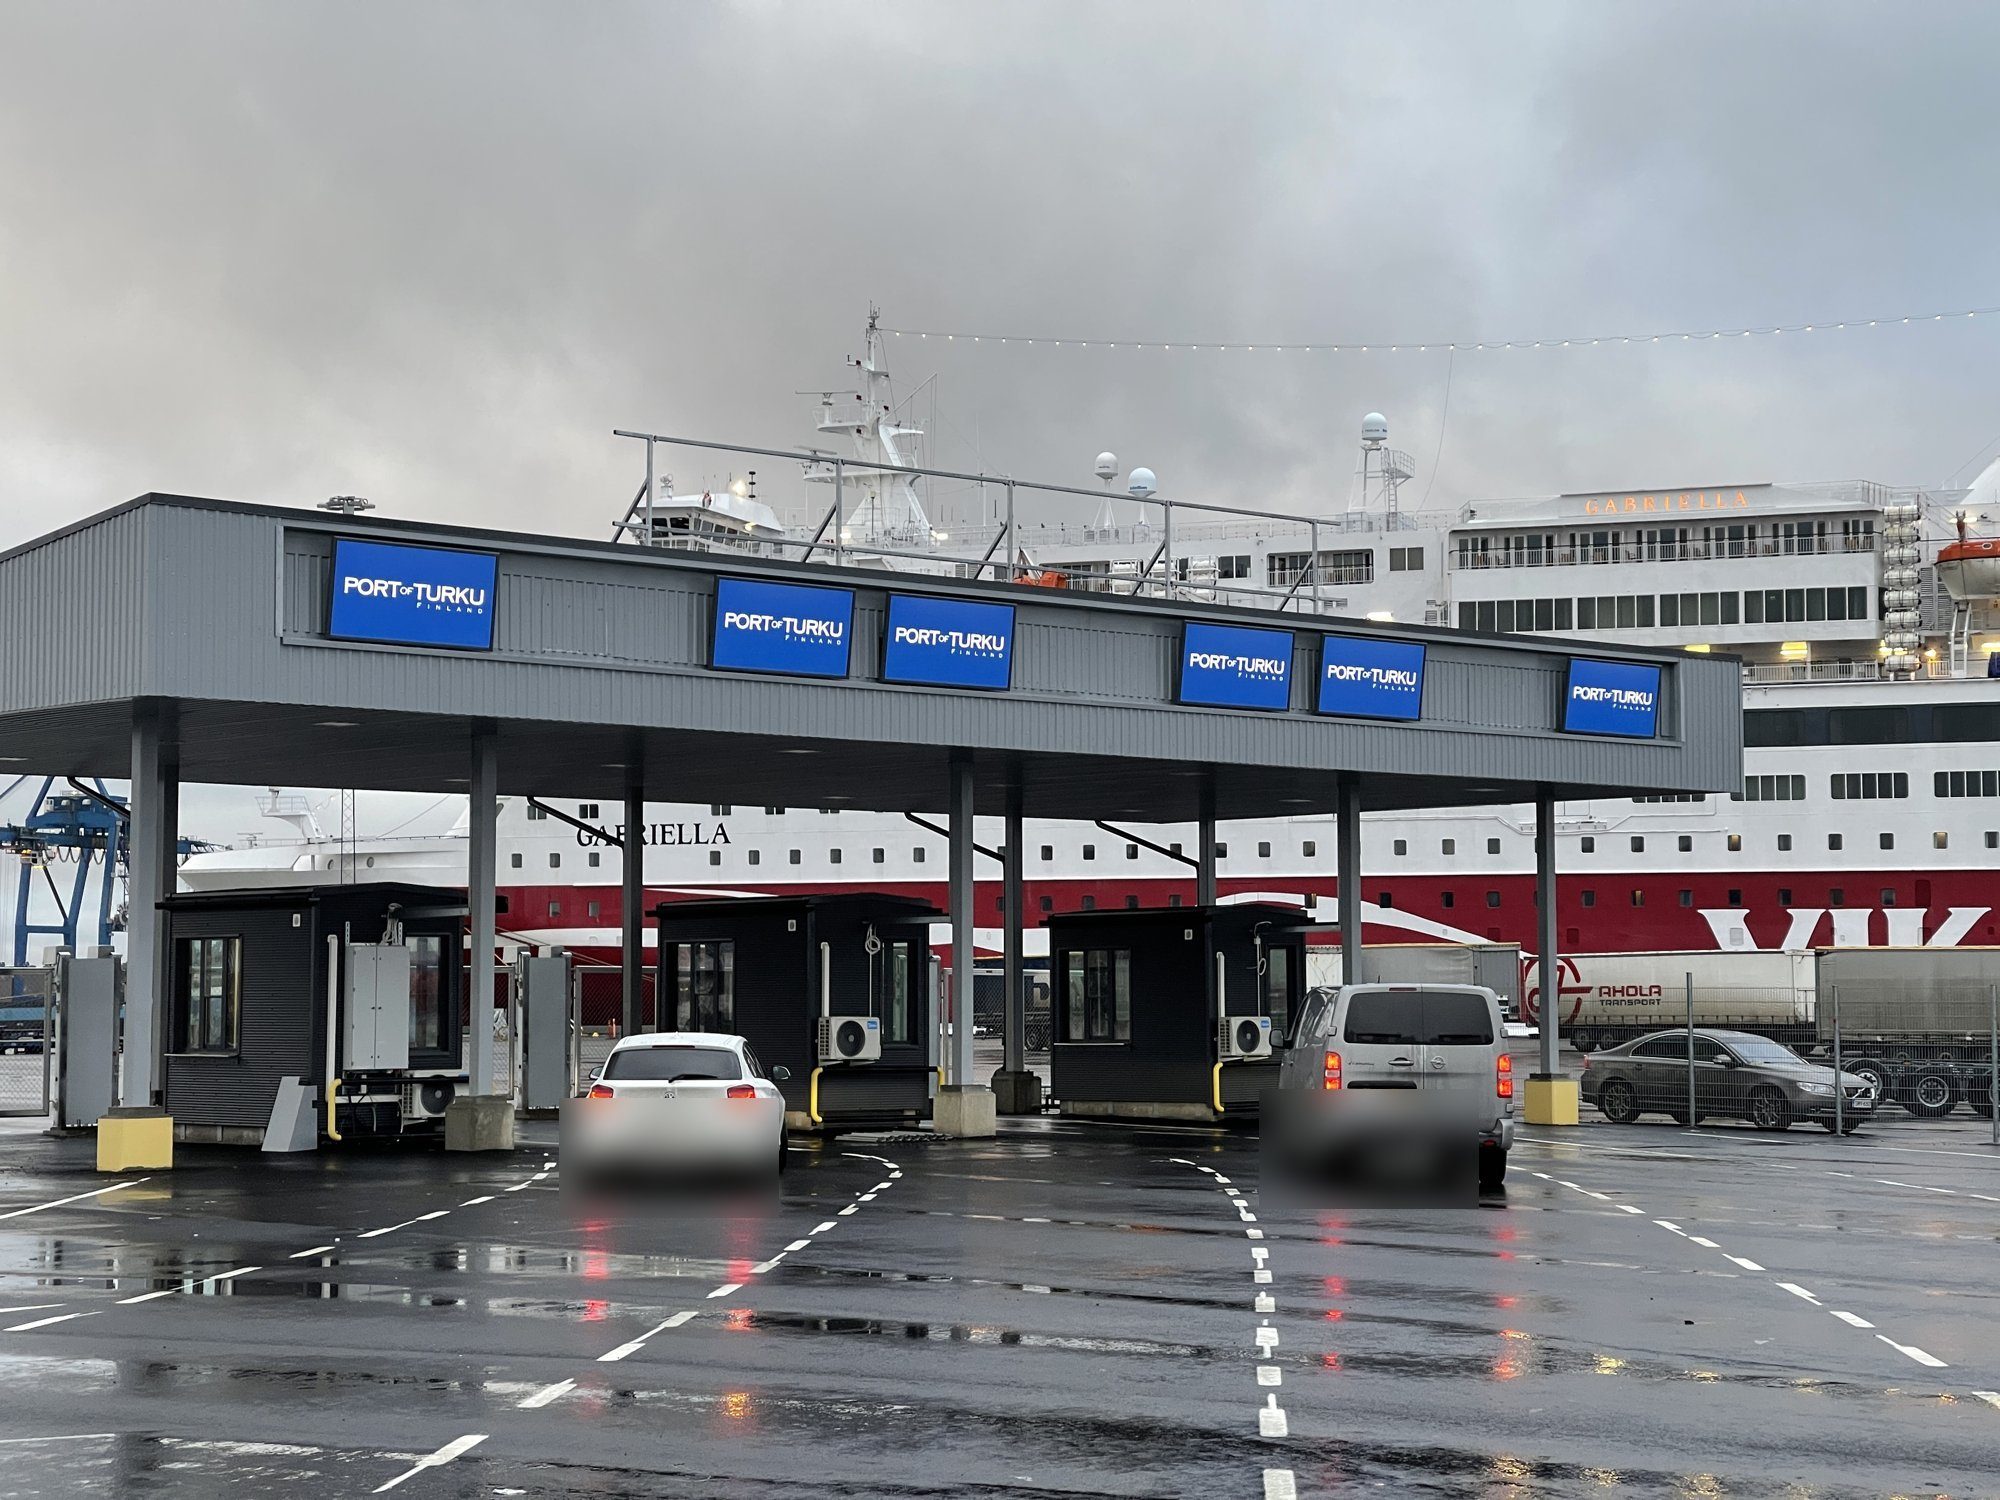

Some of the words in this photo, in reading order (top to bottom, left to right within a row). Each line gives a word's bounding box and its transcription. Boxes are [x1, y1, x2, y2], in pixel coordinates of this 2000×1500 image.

[1584, 490, 1749, 515] GABRIELLA
[344, 576, 402, 598] PORT
[400, 586, 413, 595] OF
[413, 582, 485, 606] TURKU
[416, 602, 483, 614] FINLAND
[724, 612, 773, 631] PORT
[771, 620, 783, 629] OF
[782, 616, 843, 638] TURKU
[784, 634, 842, 645] FINLAND
[895, 626, 940, 645] PORT
[938, 634, 949, 643] OF
[948, 631, 1005, 651] TURKU
[950, 648, 1003, 658] FINLAND
[1189, 652, 1229, 669] PORT
[1227, 659, 1237, 667] OF
[1236, 656, 1285, 674] TURKU
[1327, 664, 1364, 680] PORT
[1363, 671, 1372, 679] OF
[1371, 668, 1417, 686] TURKU
[1573, 686, 1606, 701] PORT
[1612, 689, 1652, 706] TURKU
[1599, 985, 1662, 997] AHOLA
